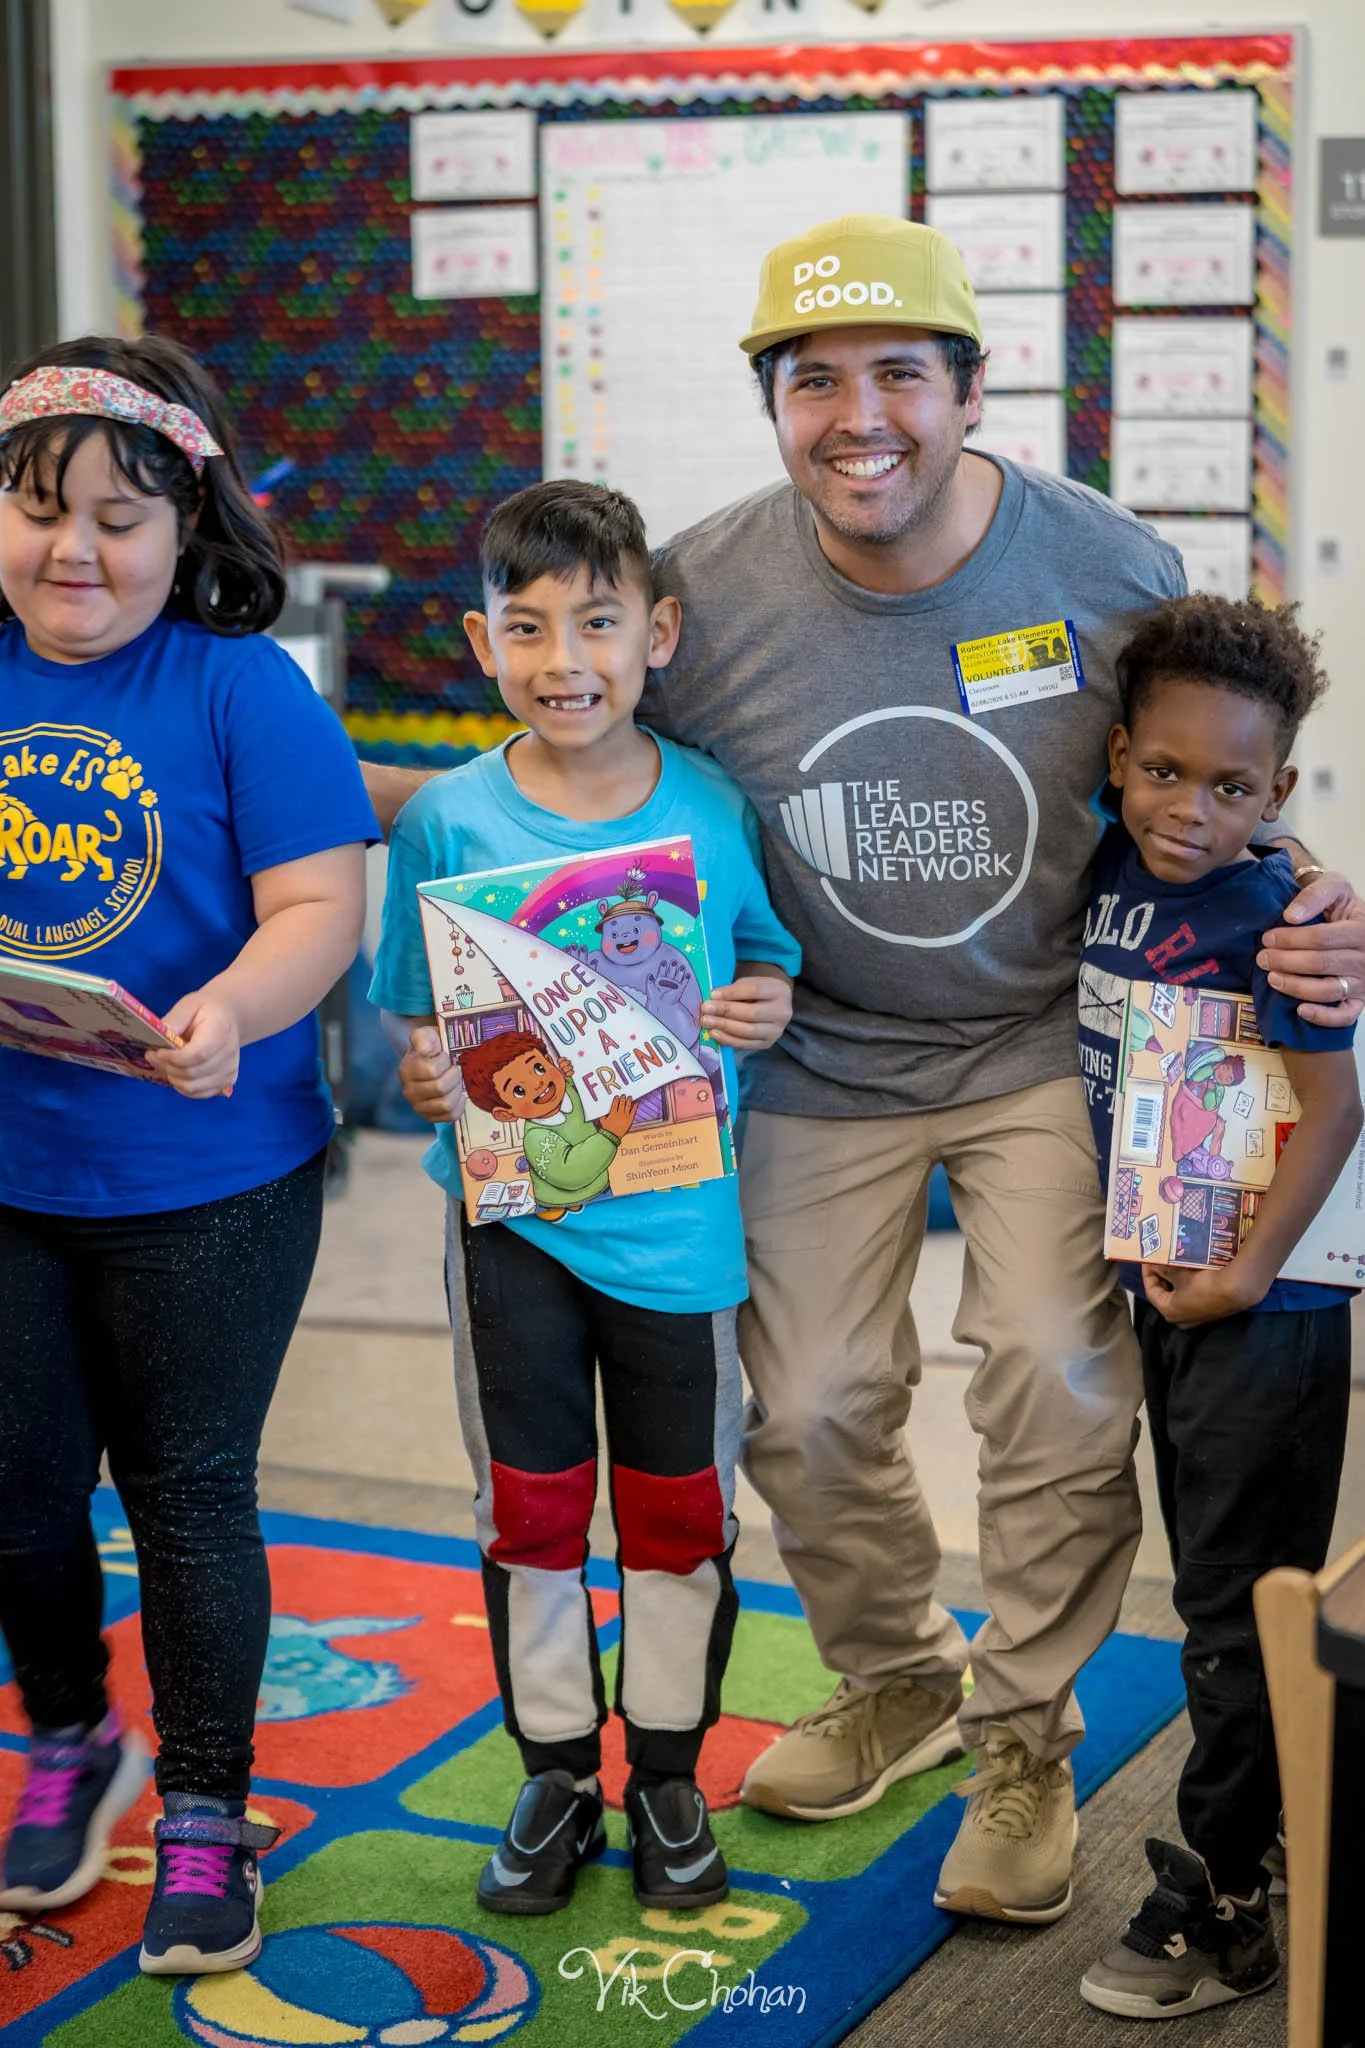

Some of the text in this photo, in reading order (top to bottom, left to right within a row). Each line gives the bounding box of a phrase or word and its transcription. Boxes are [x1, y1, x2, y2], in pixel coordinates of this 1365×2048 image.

[793, 255, 841, 287] DO
[794, 281, 903, 314] GOOD.
[960, 627, 1060, 655] Robert E. Lake Elementary
[966, 664, 1025, 683] VOLUNTEER
[1019, 690, 1029, 698] AM
[60, 749, 105, 791] ES
[846, 780, 901, 803] THE
[854, 800, 987, 829] LEADERS
[0, 806, 113, 867] ROAR
[857, 827, 992, 857] READERS
[858, 852, 1014, 882] NETWORK
[36, 906, 110, 943] LANGUAGE
[104, 857, 144, 911] SCHOOL
[532, 963, 595, 1016] ONCE
[550, 984, 627, 1045] UPON
[598, 1028, 619, 1055] A
[582, 1035, 677, 1102] FRIEND
[620, 1135, 699, 1157] Dan Gemeinhart
[626, 1161, 699, 1182] ShinYeon Moon
[1354, 1181, 1364, 1209] behind
